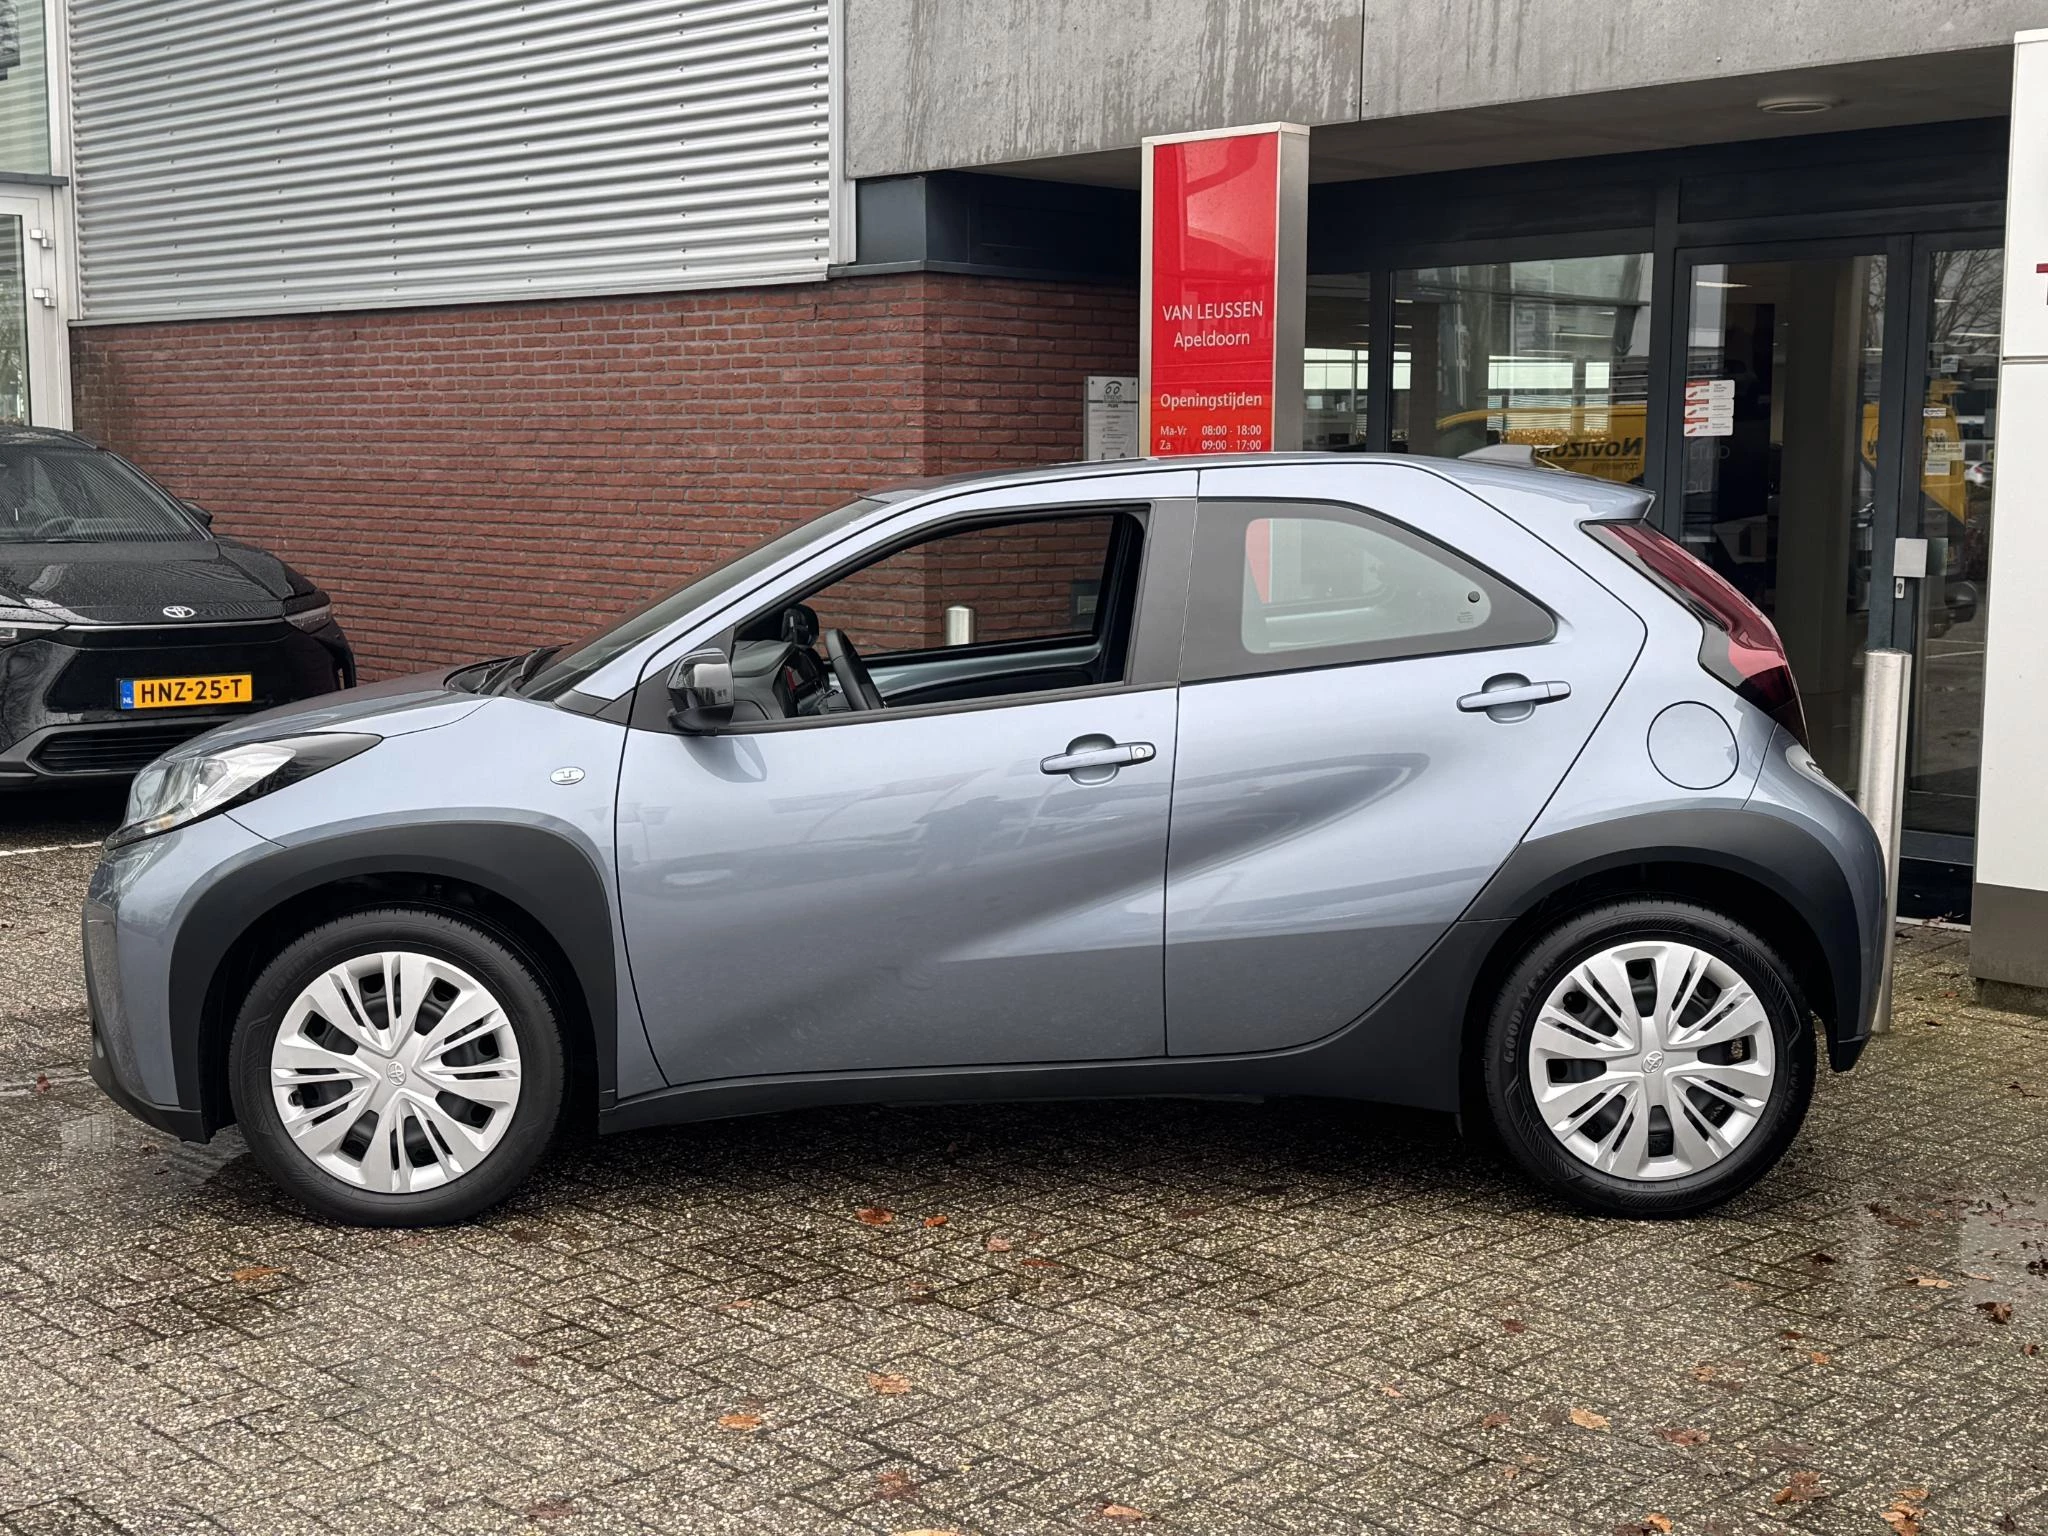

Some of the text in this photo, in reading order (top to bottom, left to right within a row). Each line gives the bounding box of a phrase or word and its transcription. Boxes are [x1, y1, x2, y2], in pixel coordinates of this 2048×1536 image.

[1162, 300, 1263, 321] VAN LEUSSEN
[1173, 330, 1250, 351] Apeldoorn
[1160, 391, 1262, 411] Openingstijden
[1160, 425, 1188, 436] Ma-Vr
[1201, 425, 1227, 436] 08:00
[1237, 424, 1262, 435] 18:00
[1159, 439, 1172, 450] Za
[1201, 439, 1227, 450] 09:00
[1236, 439, 1262, 450] 17:00
[123, 697, 134, 705] NL
[141, 679, 243, 704] HNZ-25-T
